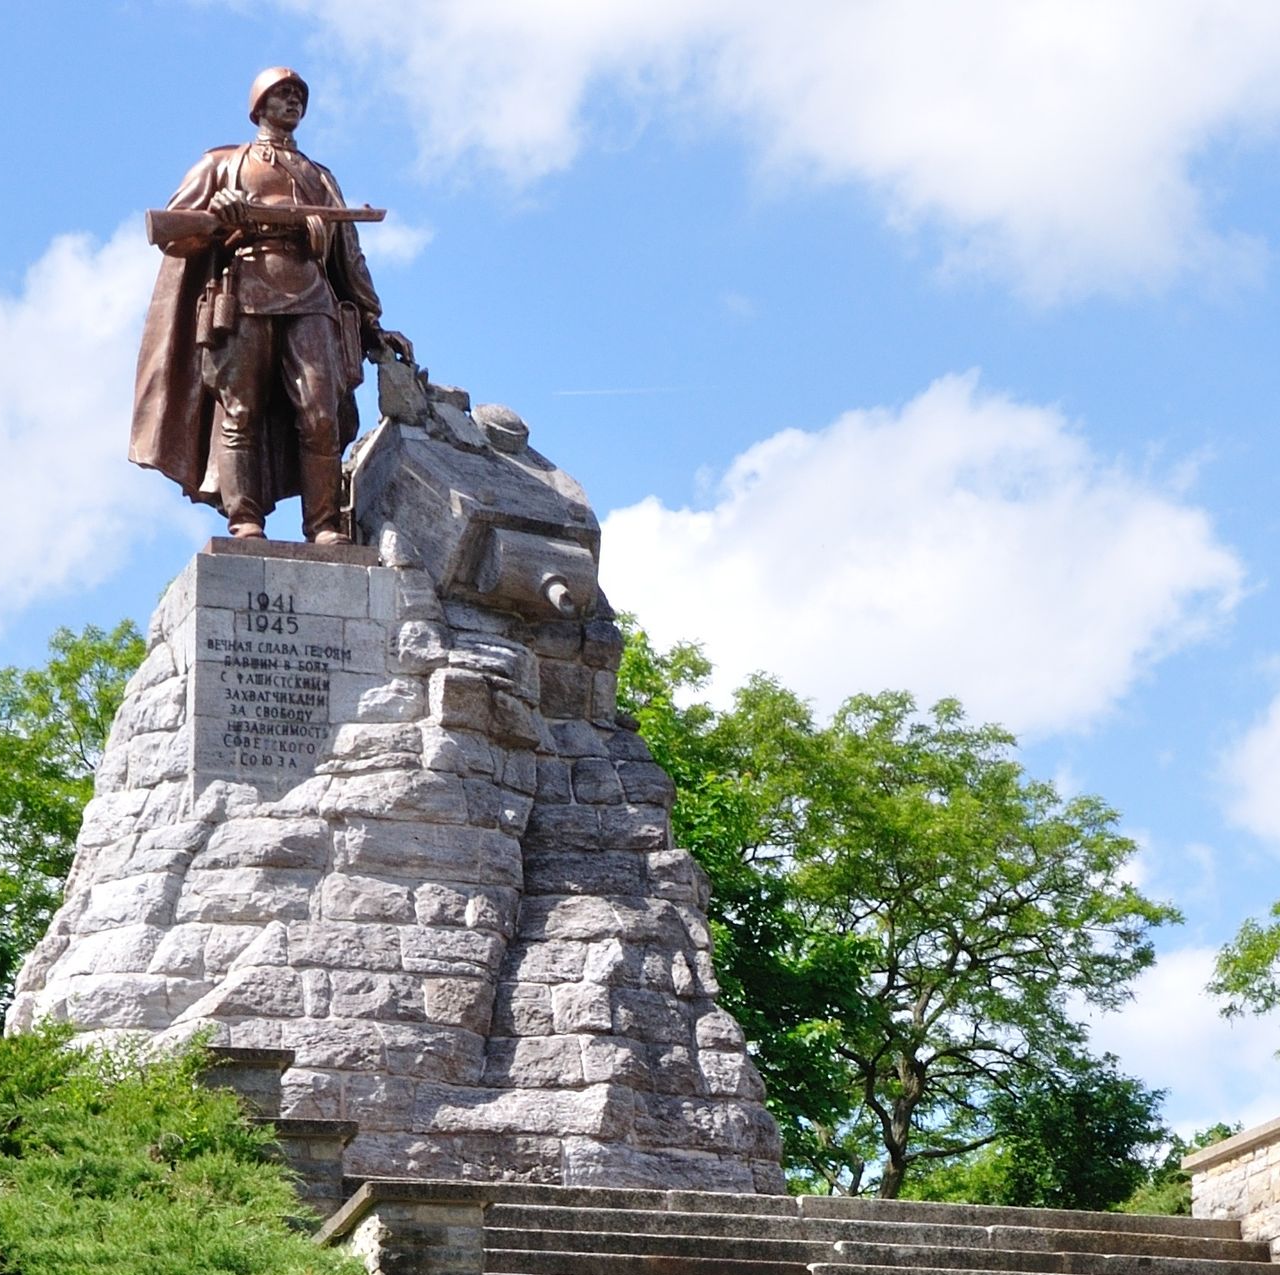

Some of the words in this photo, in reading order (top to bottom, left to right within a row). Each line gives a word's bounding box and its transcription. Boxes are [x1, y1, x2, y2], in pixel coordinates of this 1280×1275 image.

[247, 592, 295, 613] 1941
[247, 613, 299, 635] 1945
[207, 639, 252, 653] ВЕЧНАЯ
[258, 642, 298, 656] СЛАВА
[224, 655, 277, 669] ПАВШИМ
[284, 659, 291, 671] В
[299, 661, 329, 673] БОЯХ
[220, 671, 227, 682] С
[237, 673, 330, 691] ФАШИСТСКИМИ
[225, 688, 325, 707] ЗАХВАТЧИКАМИ
[230, 703, 246, 716] ЗА
[255, 706, 312, 721] СВОБОДУ
[227, 721, 328, 739] НЕЗАВИСИМОСТЬ
[240, 751, 297, 768] СОЮЗА
